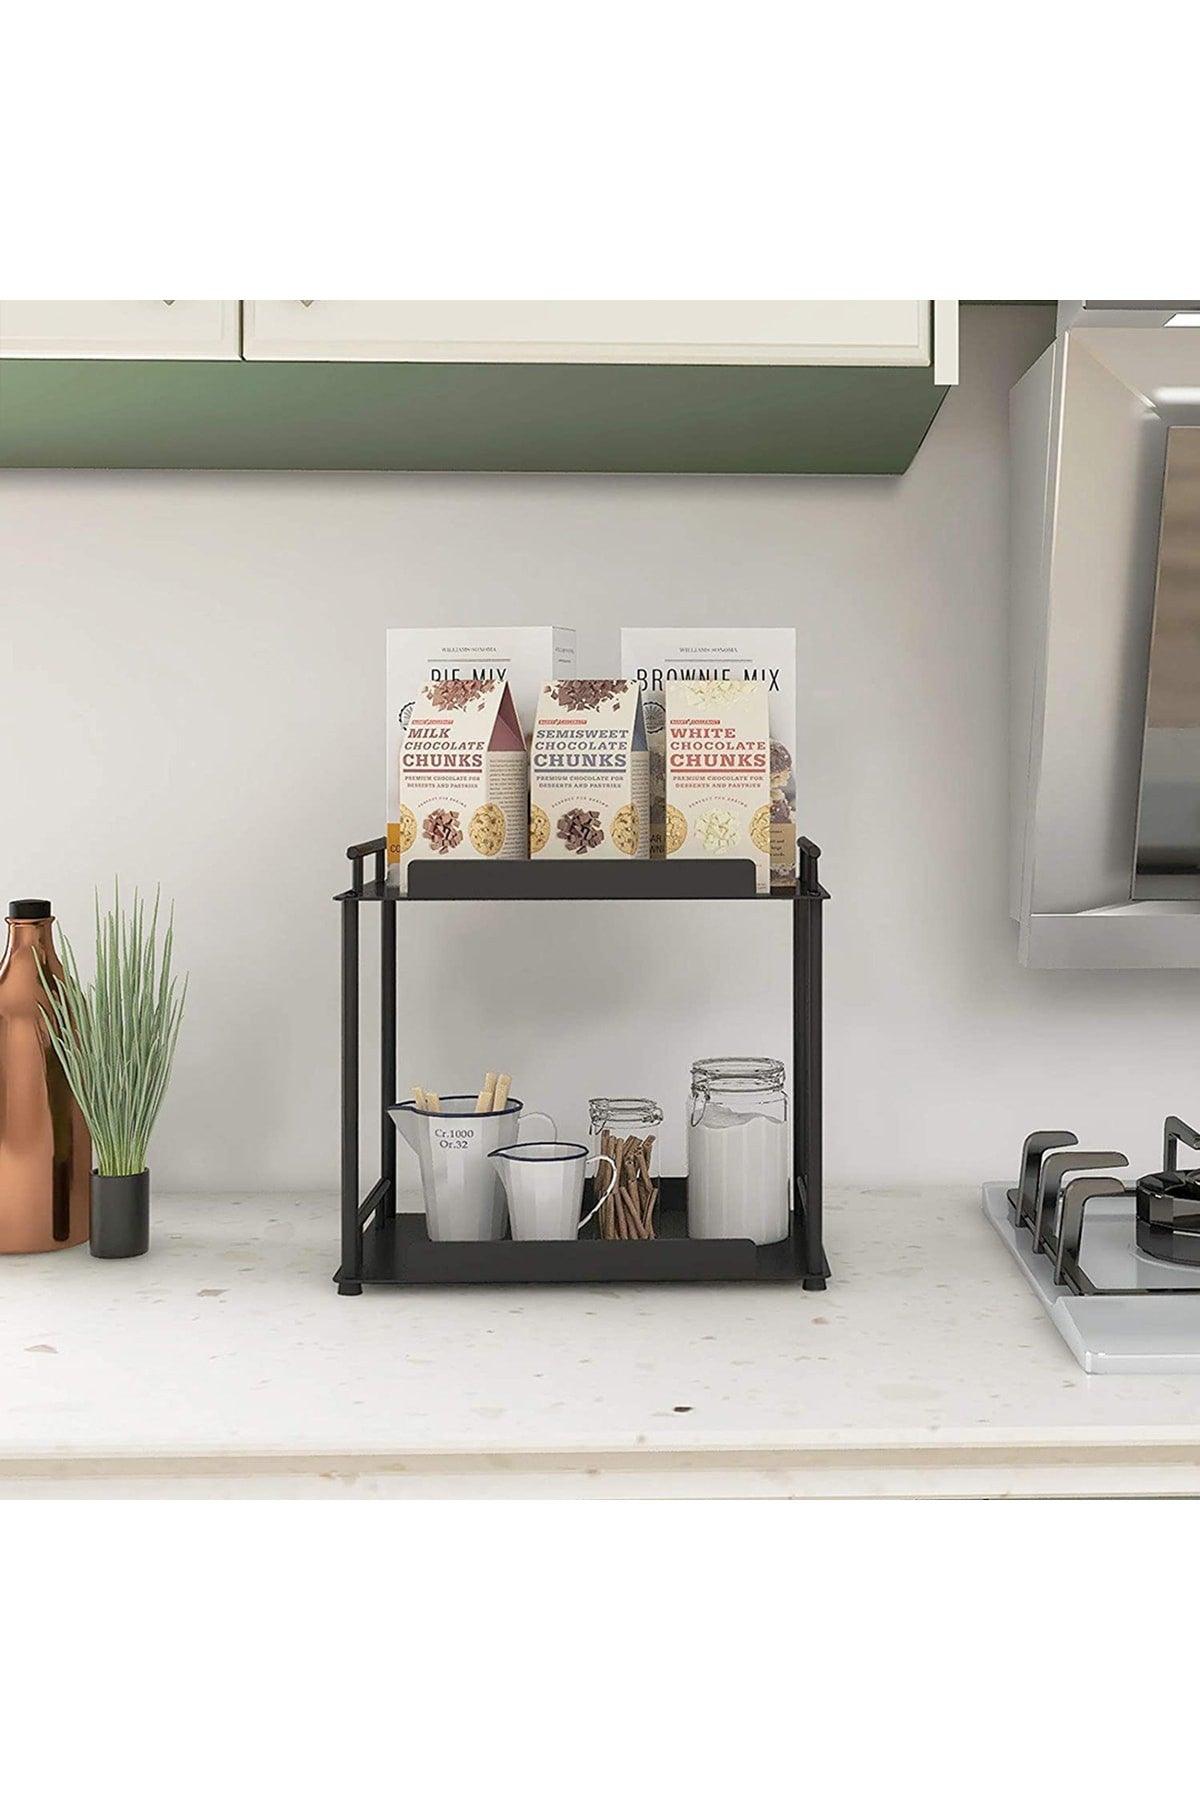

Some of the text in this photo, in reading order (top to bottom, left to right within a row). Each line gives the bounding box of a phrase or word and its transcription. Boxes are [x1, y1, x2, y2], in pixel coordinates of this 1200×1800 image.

[636, 668, 780, 691] BROWNIE MIX
[407, 728, 450, 739] MILK
[536, 729, 629, 739] SEMISWEET
[670, 728, 736, 739] WHITE
[404, 741, 485, 750] CHOCOLATE
[535, 741, 628, 751] CHOCOLATE
[670, 741, 766, 751] CHOCOLATE
[402, 753, 483, 767] CHUNKS
[533, 753, 627, 767] CHUNKS
[670, 753, 766, 767] CHUNKS
[434, 1128, 474, 1138] Cr.1000
[439, 1139, 468, 1149] Or.32
